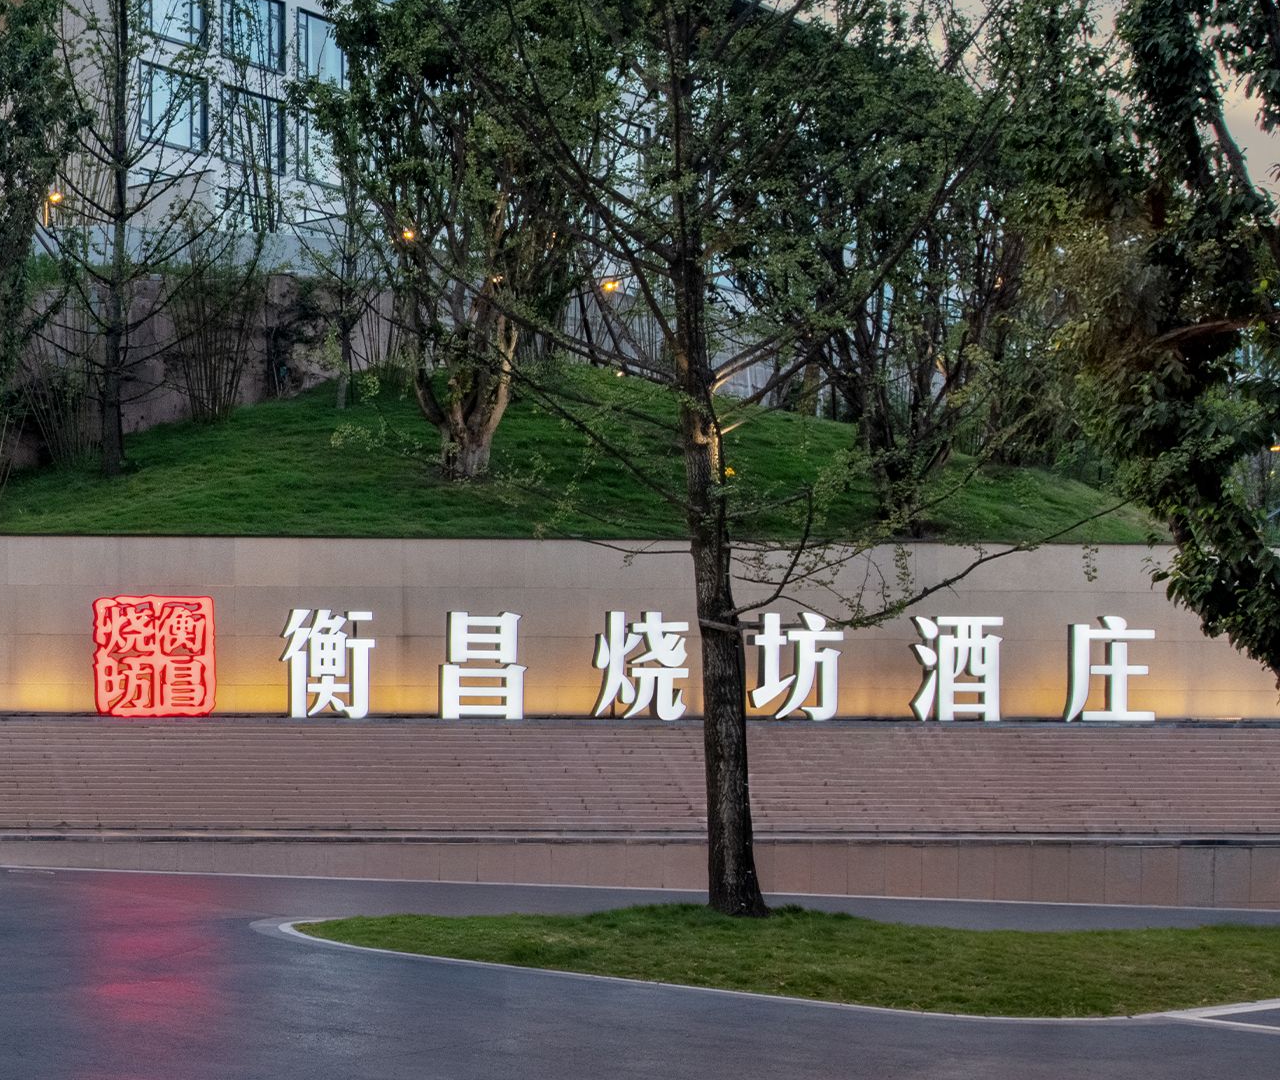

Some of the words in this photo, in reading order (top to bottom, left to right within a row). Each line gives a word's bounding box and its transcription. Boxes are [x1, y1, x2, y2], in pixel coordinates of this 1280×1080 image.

[281, 607, 1157, 723] 衡昌烧坊酒庄
